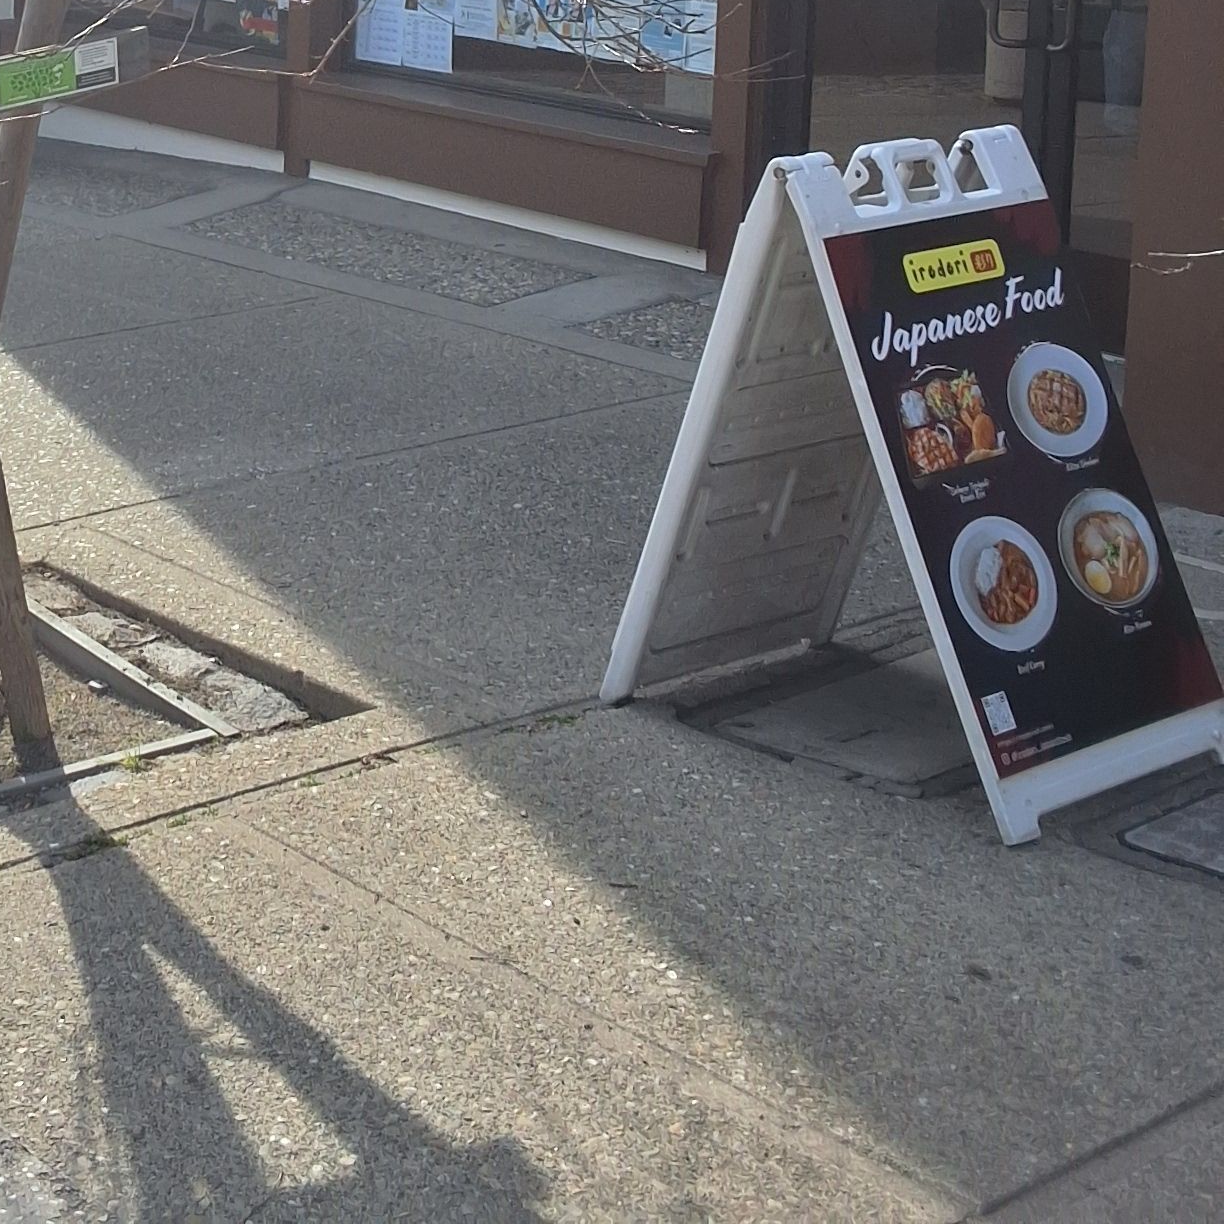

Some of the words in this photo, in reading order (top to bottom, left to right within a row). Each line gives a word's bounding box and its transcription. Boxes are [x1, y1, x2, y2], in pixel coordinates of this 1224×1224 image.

[909, 249, 969, 283] irodori
[871, 302, 1000, 367] Japanese
[1005, 267, 1064, 320] Food
